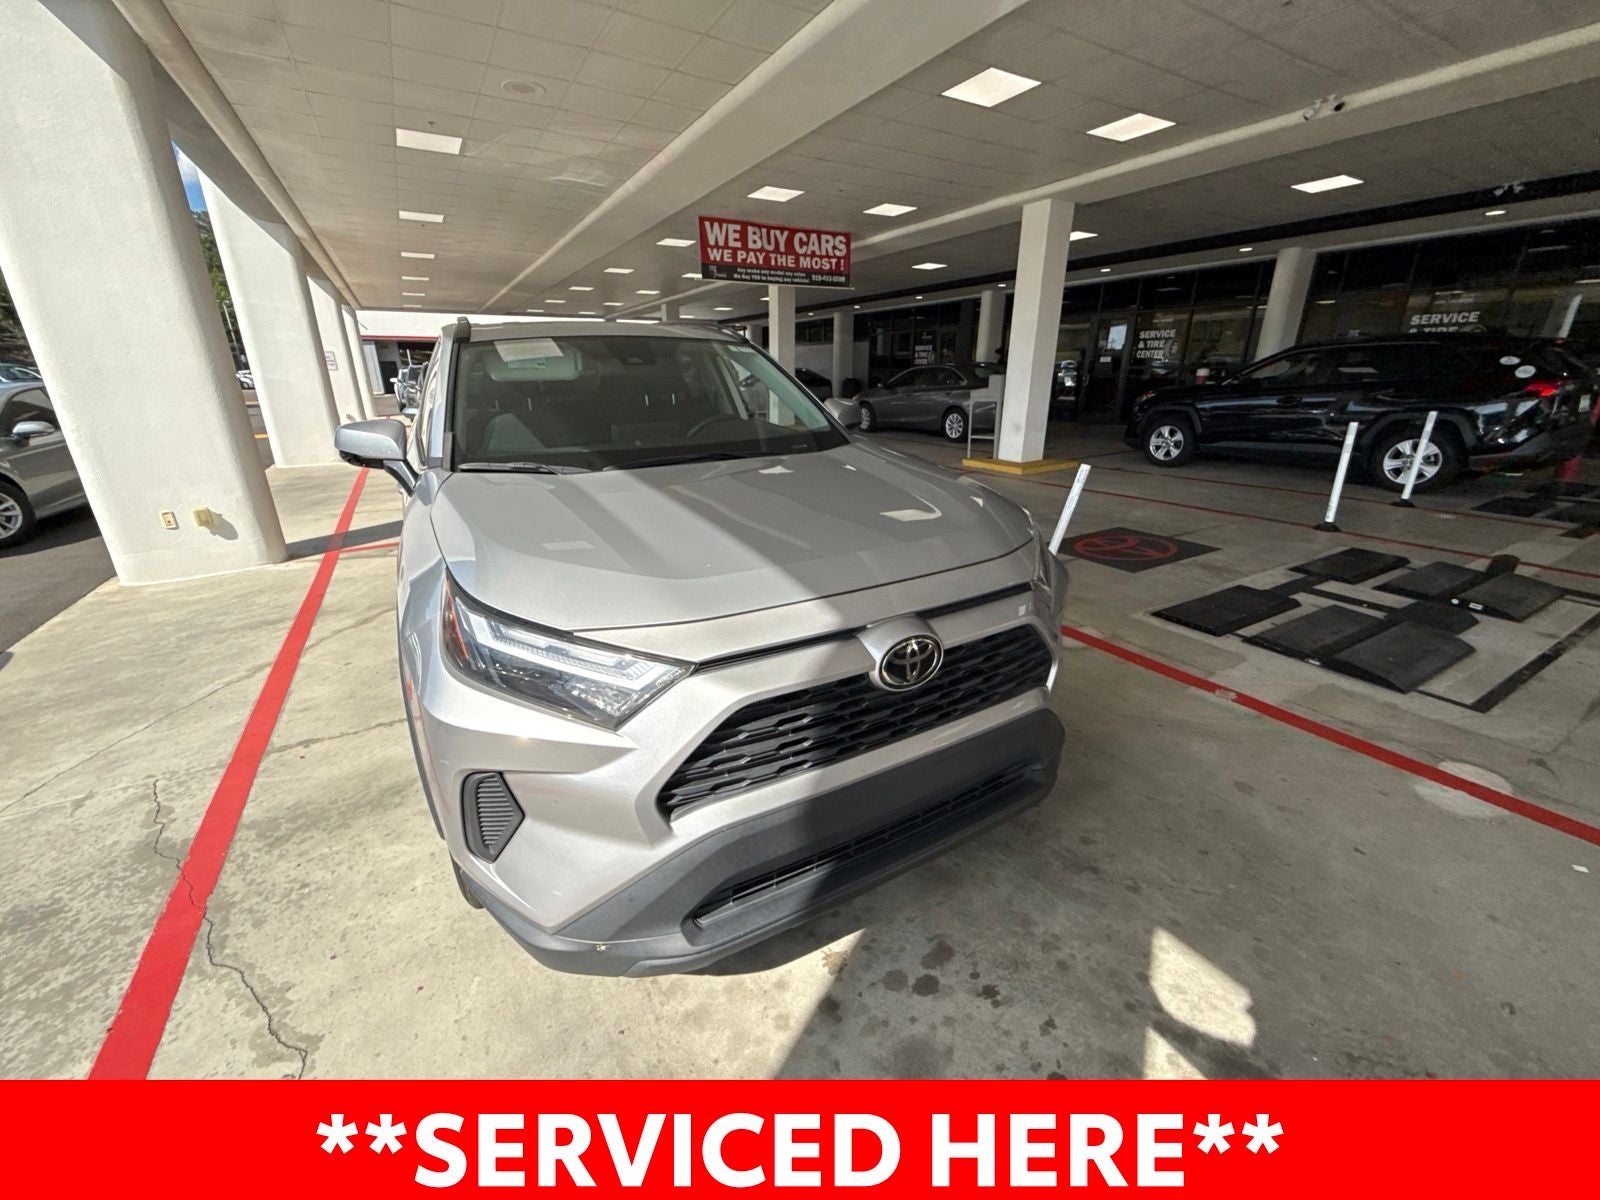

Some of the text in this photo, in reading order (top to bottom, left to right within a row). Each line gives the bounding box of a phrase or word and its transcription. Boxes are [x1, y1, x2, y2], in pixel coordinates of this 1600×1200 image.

[704, 221, 847, 257] WE BUY CARS
[707, 248, 733, 262] WE
[737, 250, 766, 264] PAY
[769, 253, 795, 267] THE
[1409, 311, 1480, 325] SERVICE
[1138, 329, 1176, 339] SERVICE
[1146, 339, 1166, 349] TIRE
[1136, 349, 1164, 359] CENTER
